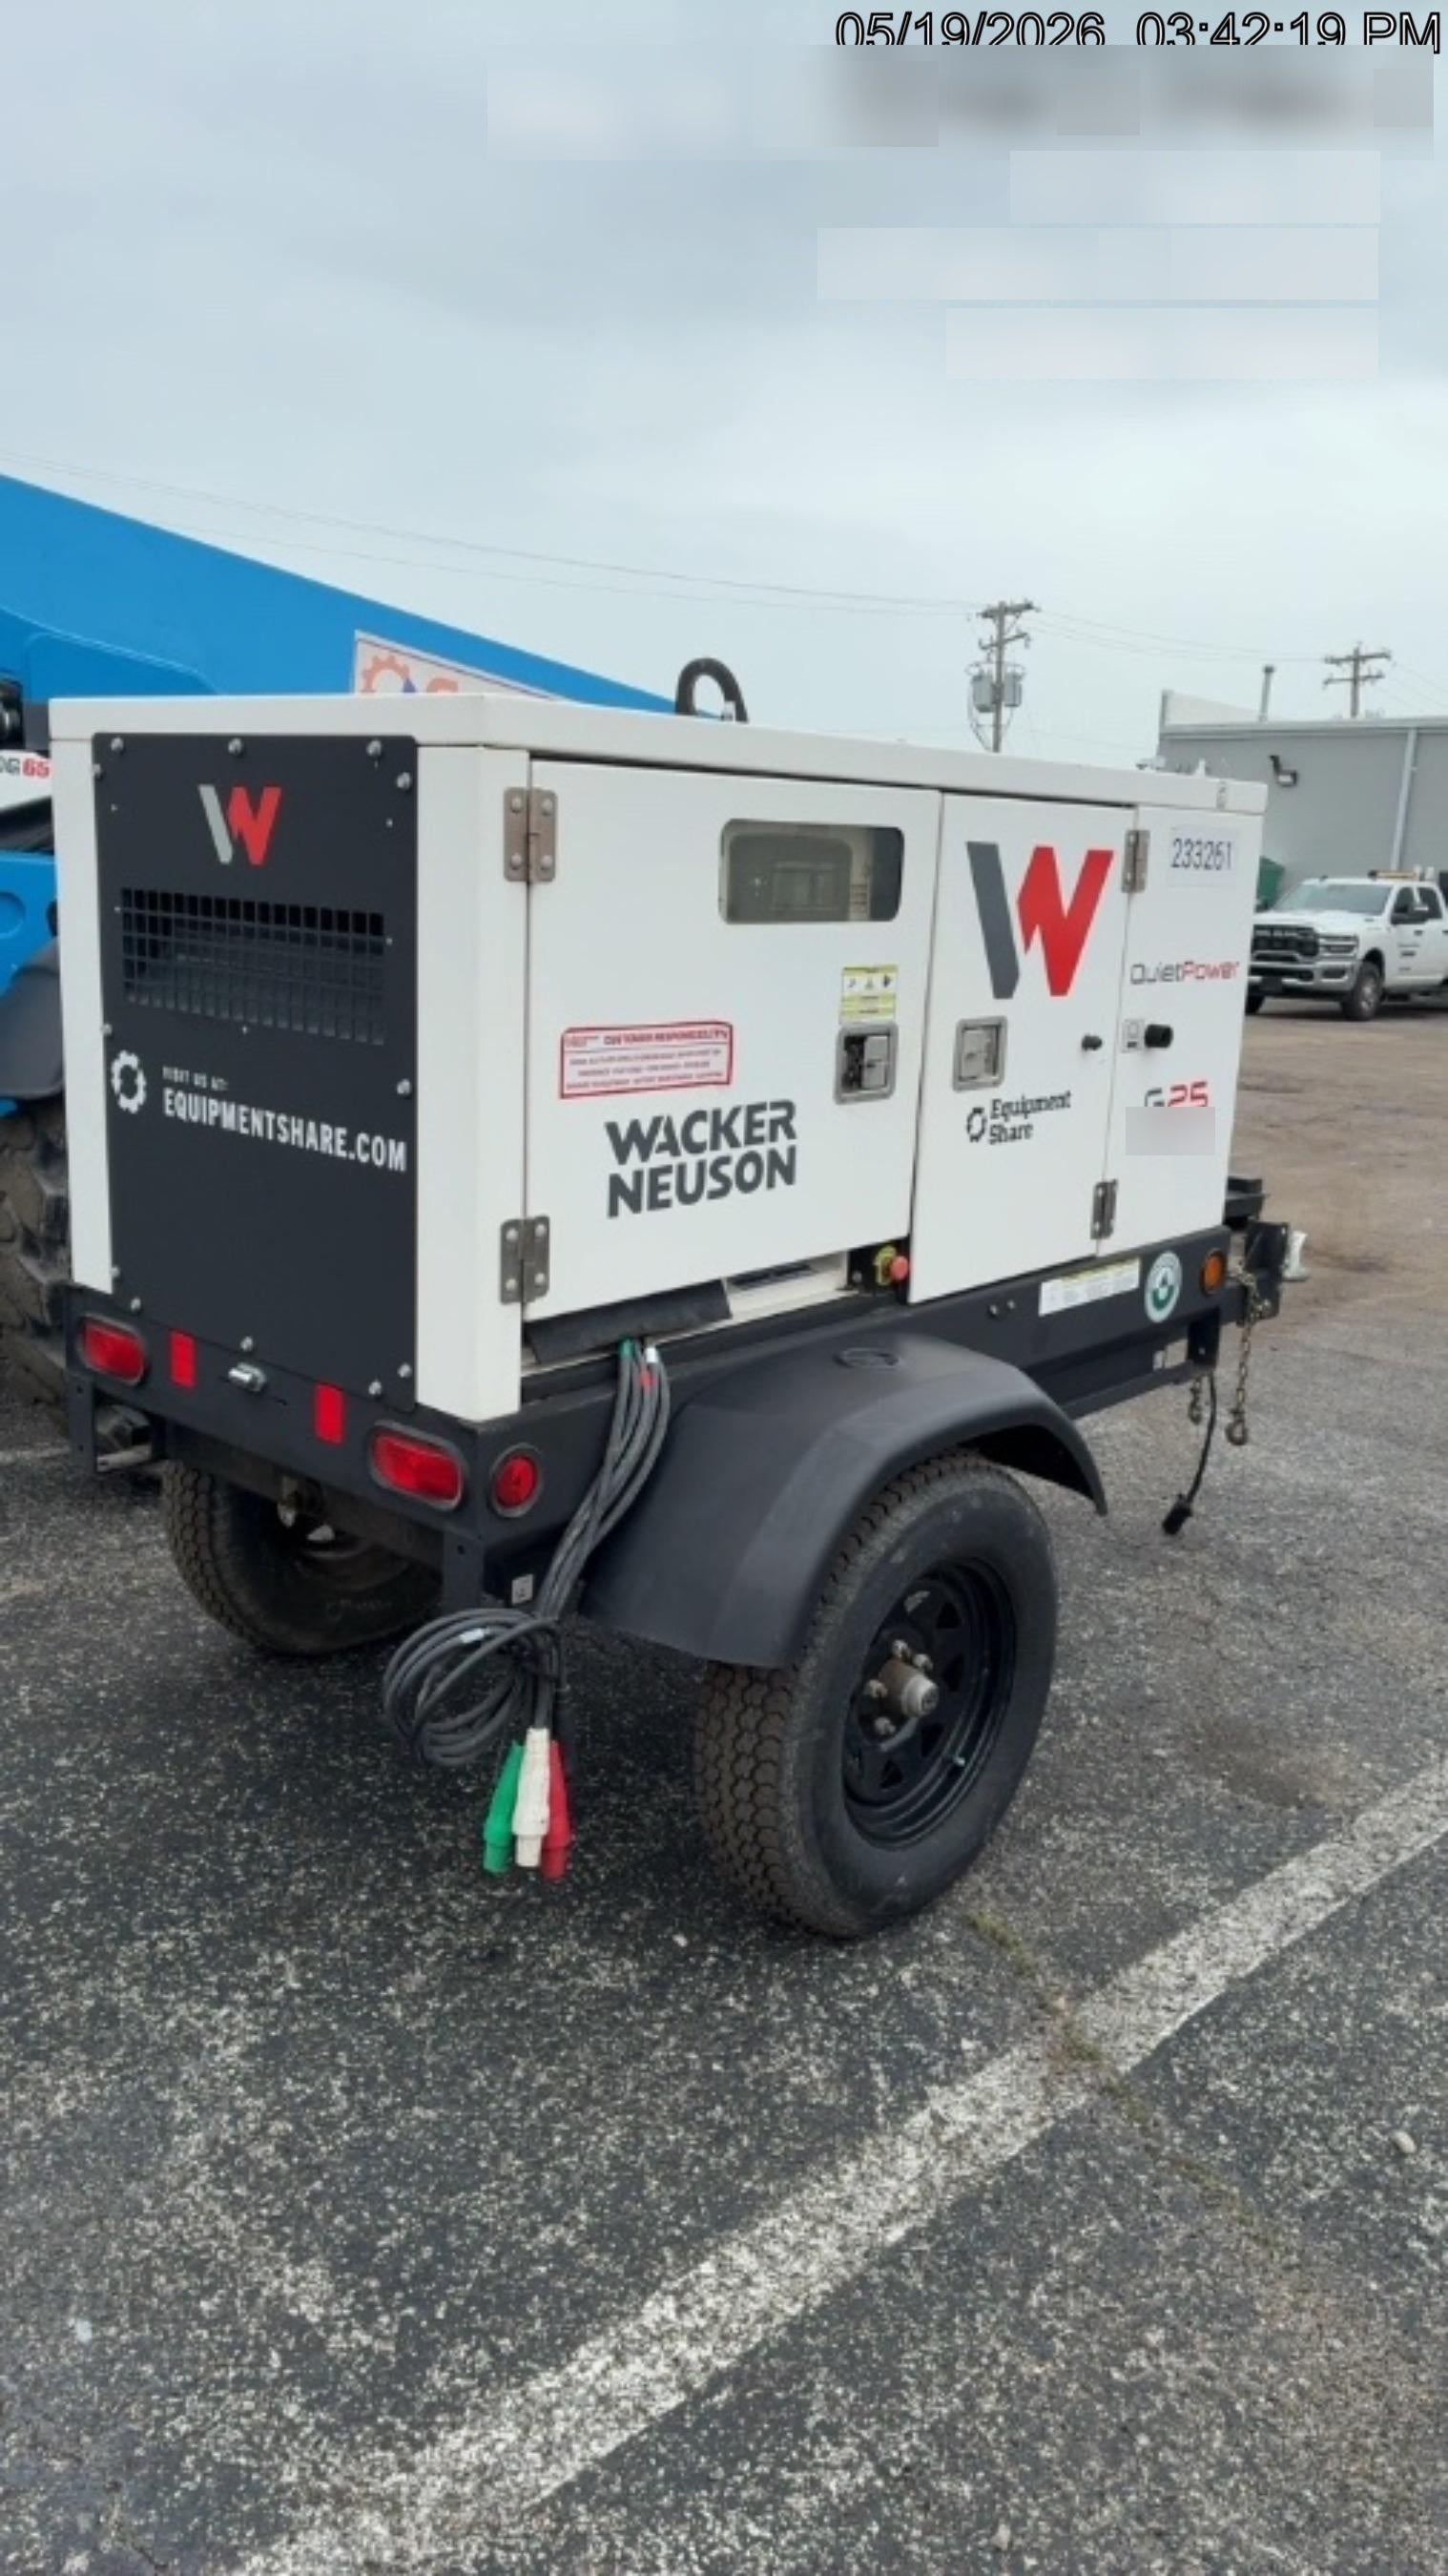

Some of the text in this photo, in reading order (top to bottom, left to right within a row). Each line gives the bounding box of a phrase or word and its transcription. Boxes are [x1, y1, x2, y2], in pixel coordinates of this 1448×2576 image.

[162, 1088, 407, 1173] EQUIPMENTSHARE.COM
[605, 1099, 797, 1166] WACKER
[989, 1124, 1033, 1145] Share
[990, 1090, 1071, 1122] Equipment
[607, 1145, 797, 1218] NEUSON
